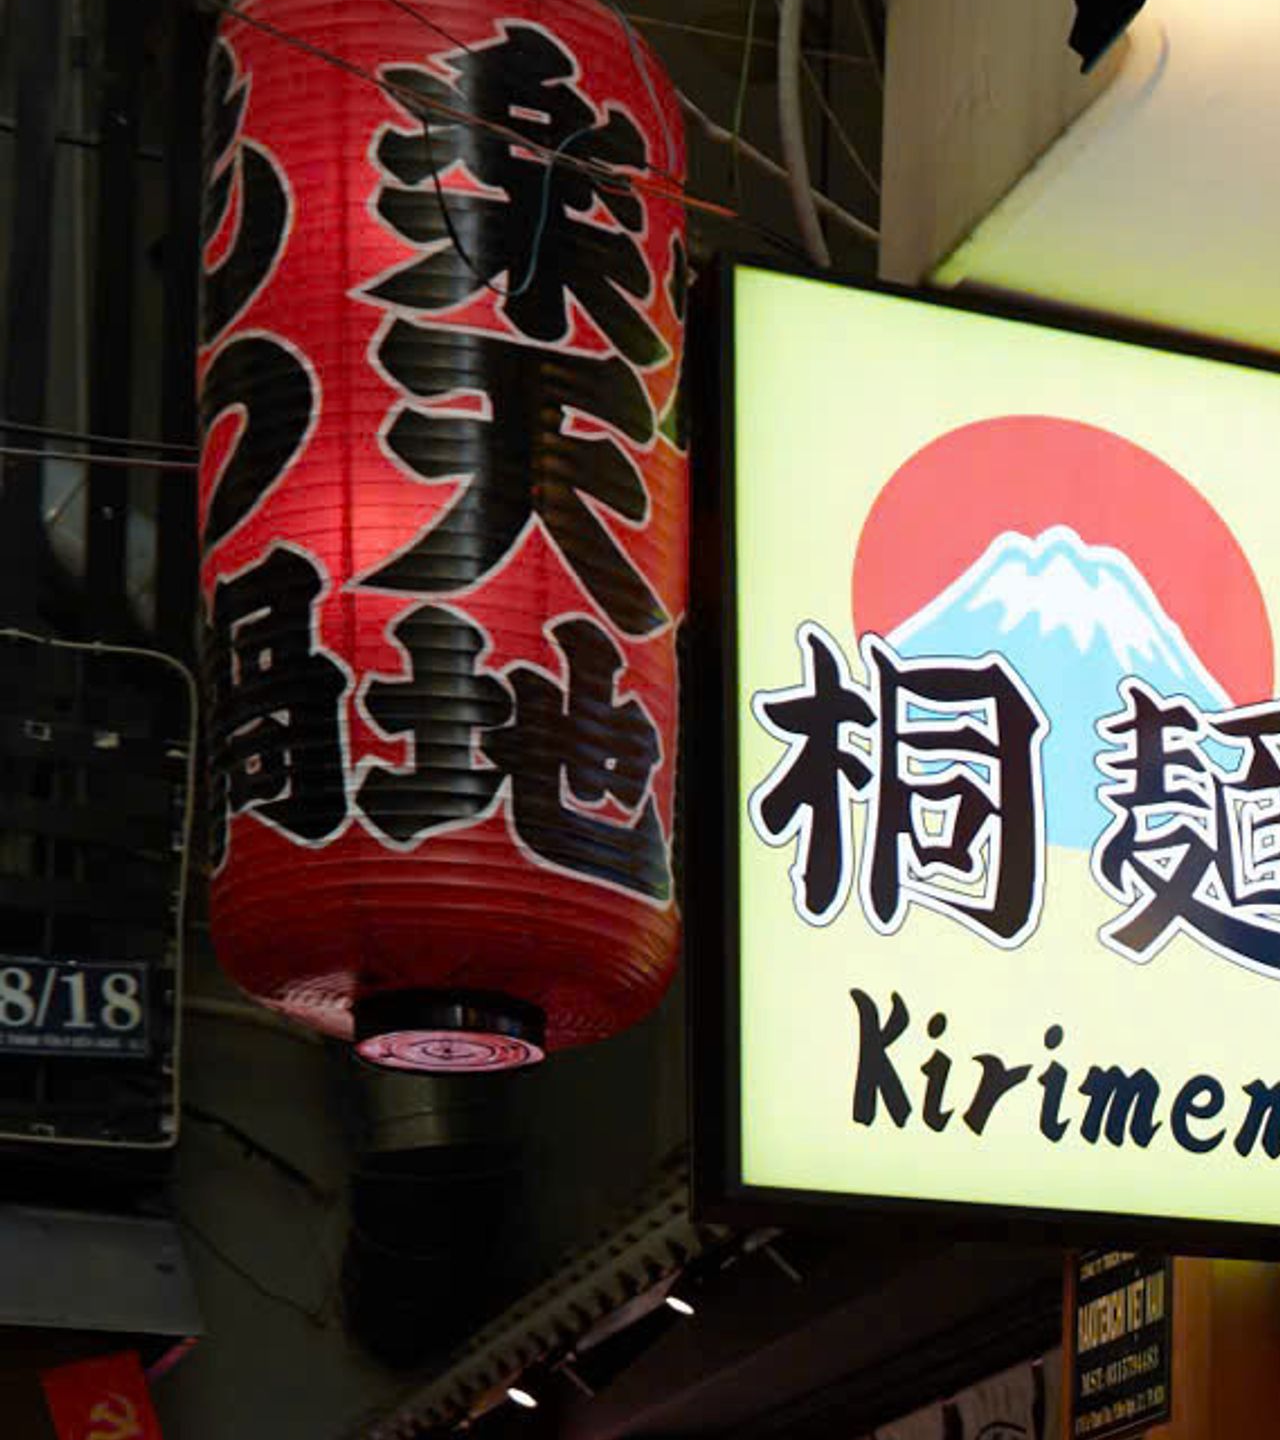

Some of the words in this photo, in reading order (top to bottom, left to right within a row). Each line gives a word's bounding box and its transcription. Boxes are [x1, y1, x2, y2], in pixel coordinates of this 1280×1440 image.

[345, 20, 672, 906] 楽天地
[0, 966, 142, 1031] 8/18
